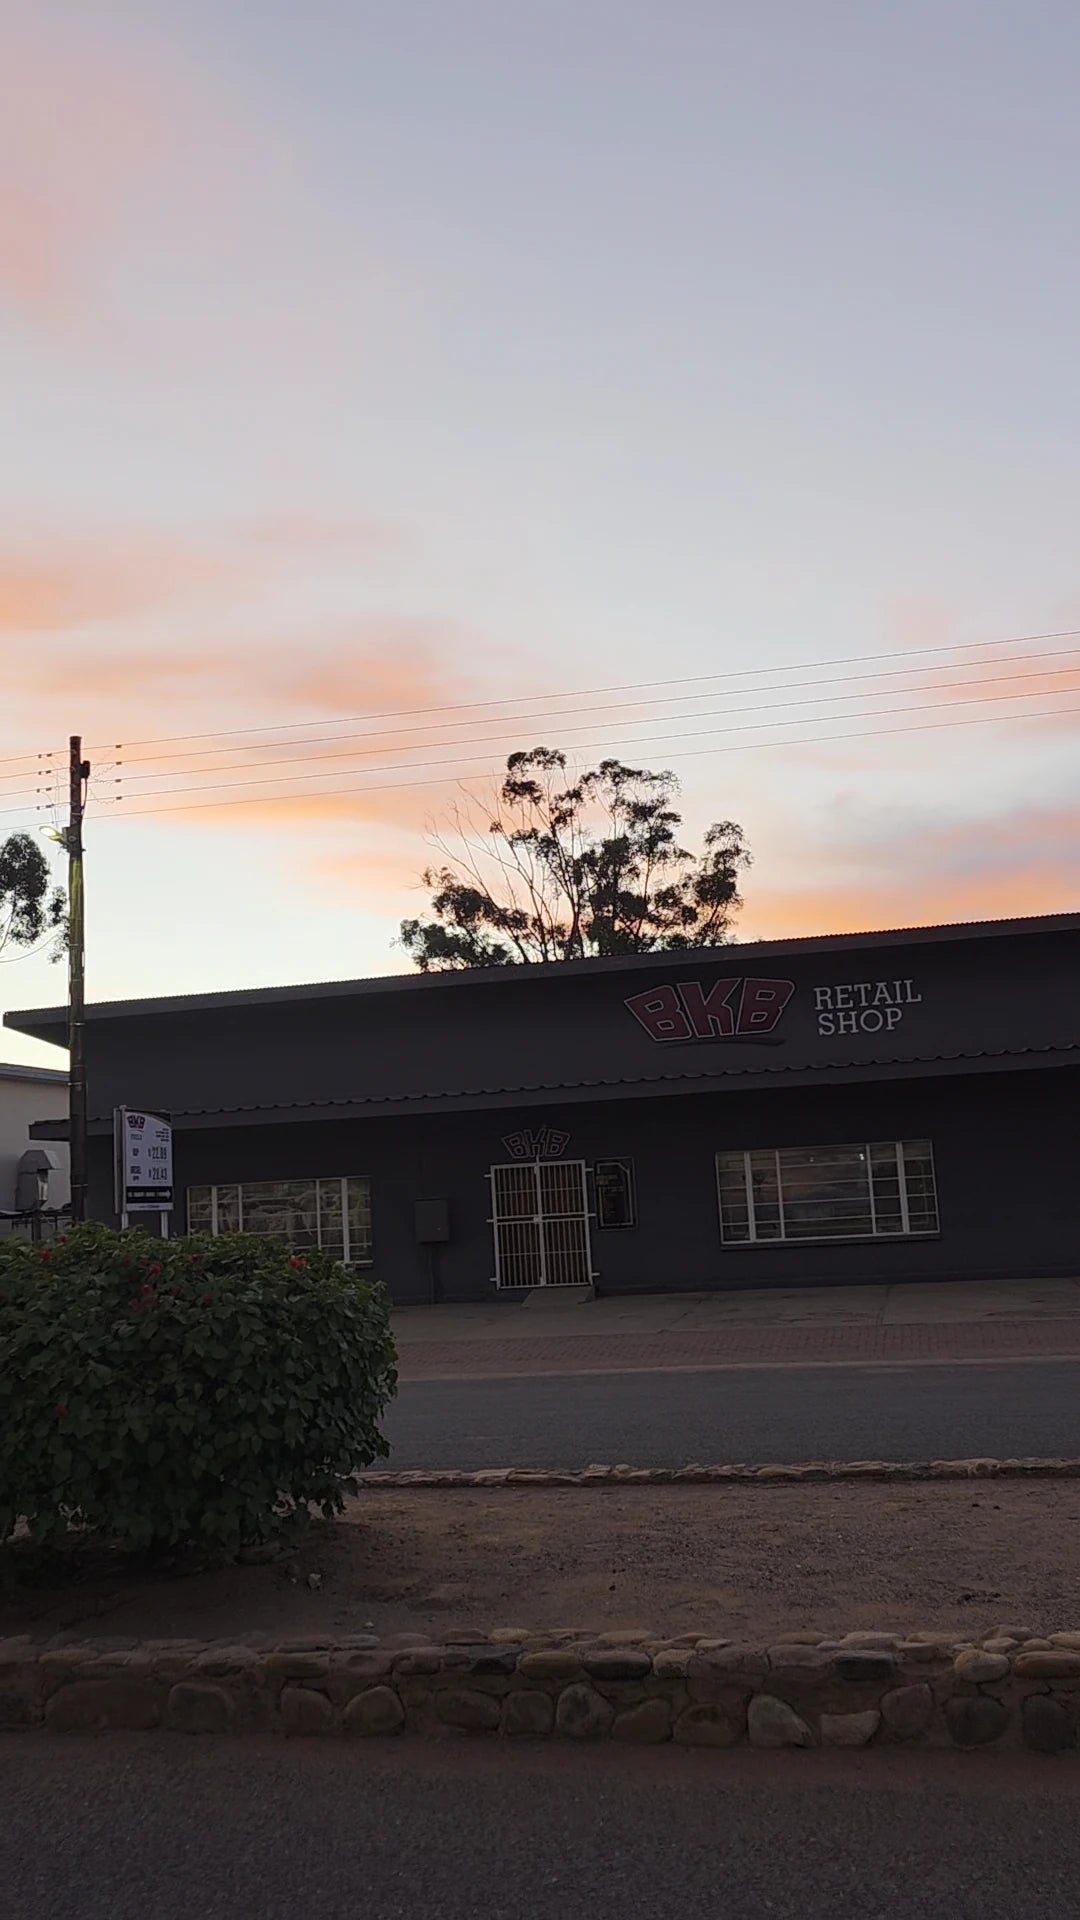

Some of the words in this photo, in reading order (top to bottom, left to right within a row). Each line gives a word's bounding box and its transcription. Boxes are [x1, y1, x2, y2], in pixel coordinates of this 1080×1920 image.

[624, 977, 796, 1042] BKB
[813, 979, 922, 1011] RETAIL
[818, 1008, 902, 1037] SHOP
[127, 1114, 146, 1129] BKB
[501, 1127, 572, 1159] BKB
